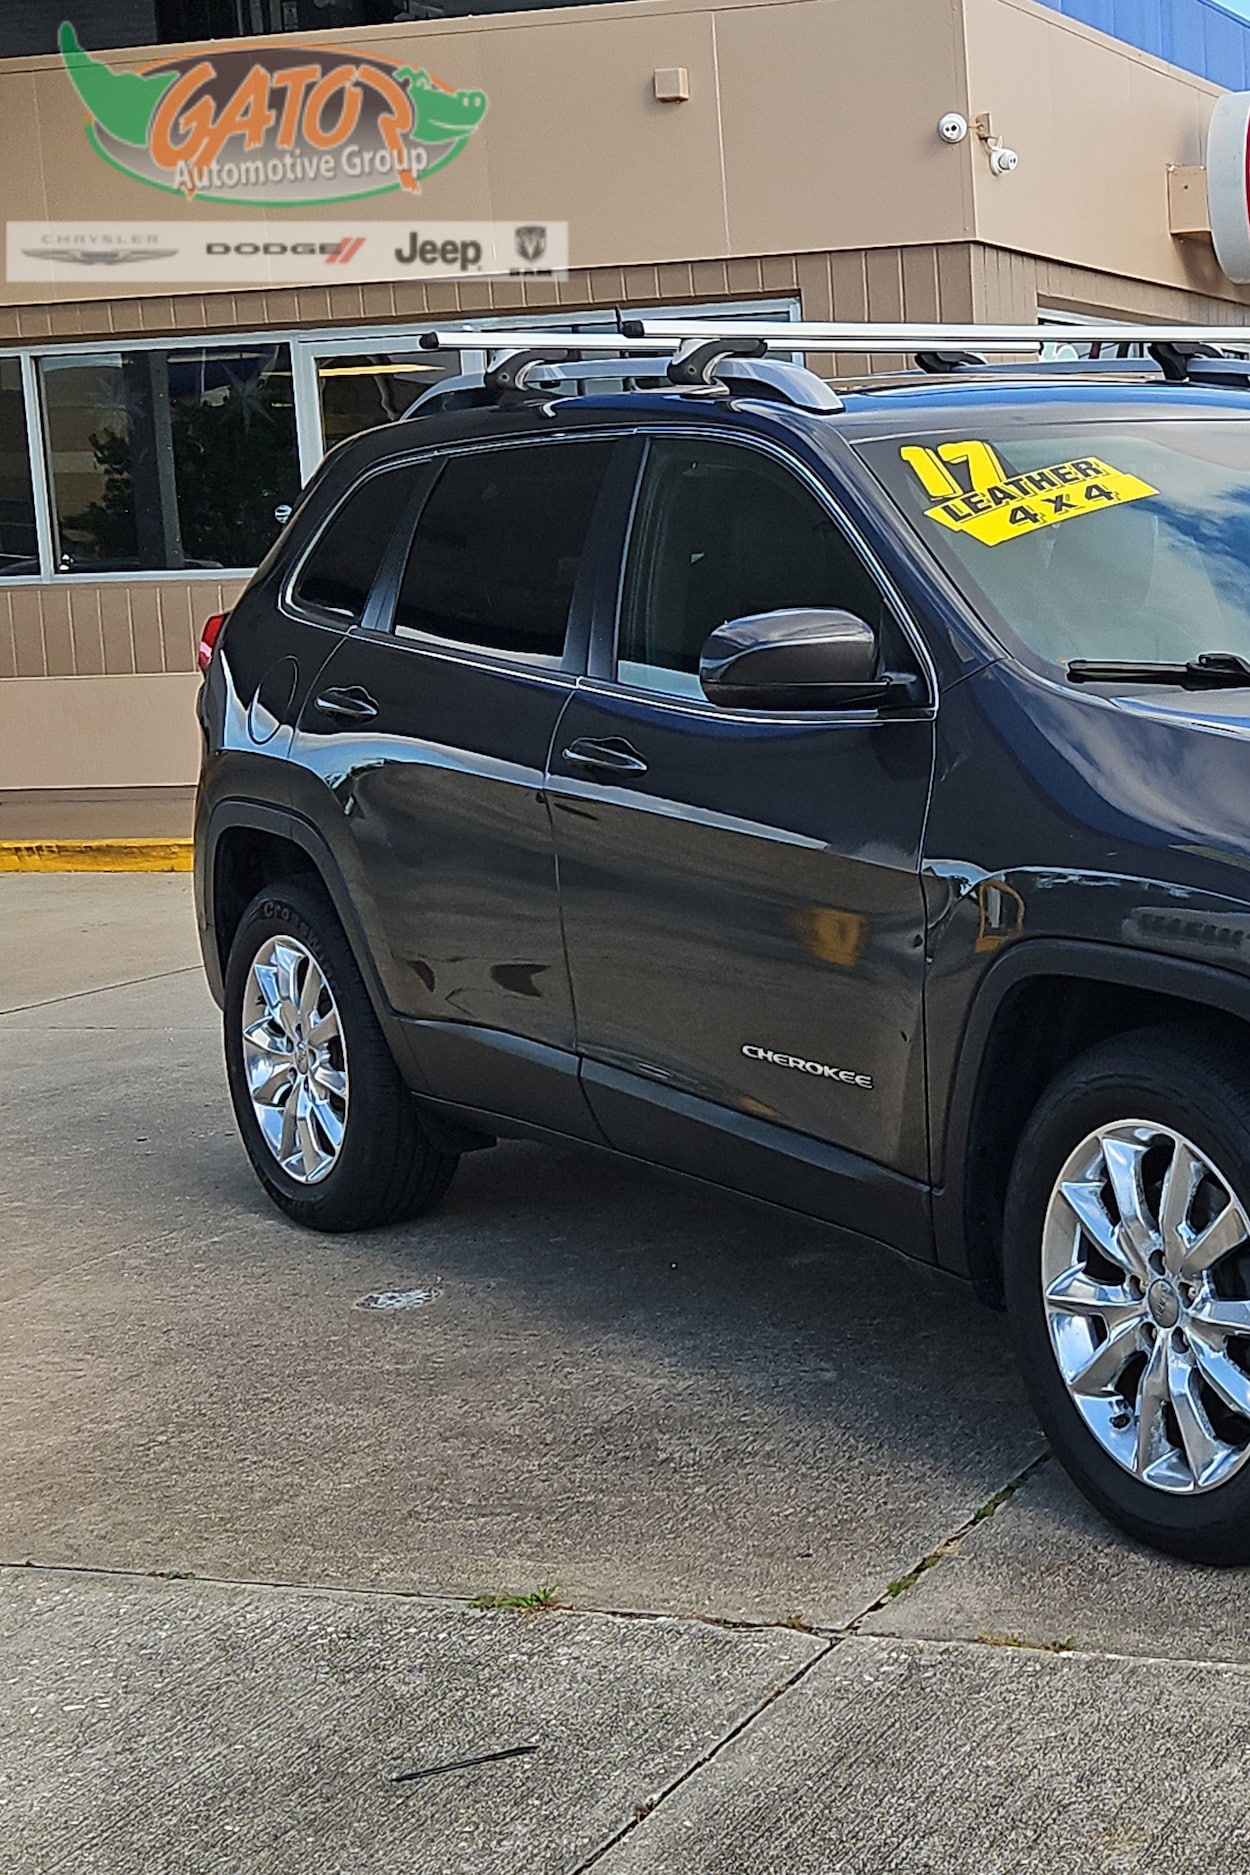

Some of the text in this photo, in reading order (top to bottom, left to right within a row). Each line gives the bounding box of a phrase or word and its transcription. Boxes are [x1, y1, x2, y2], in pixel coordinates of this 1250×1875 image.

[900, 440, 1008, 501] 17
[940, 459, 1105, 523] LEATHER
[742, 1045, 873, 1089] CHEROKEE
